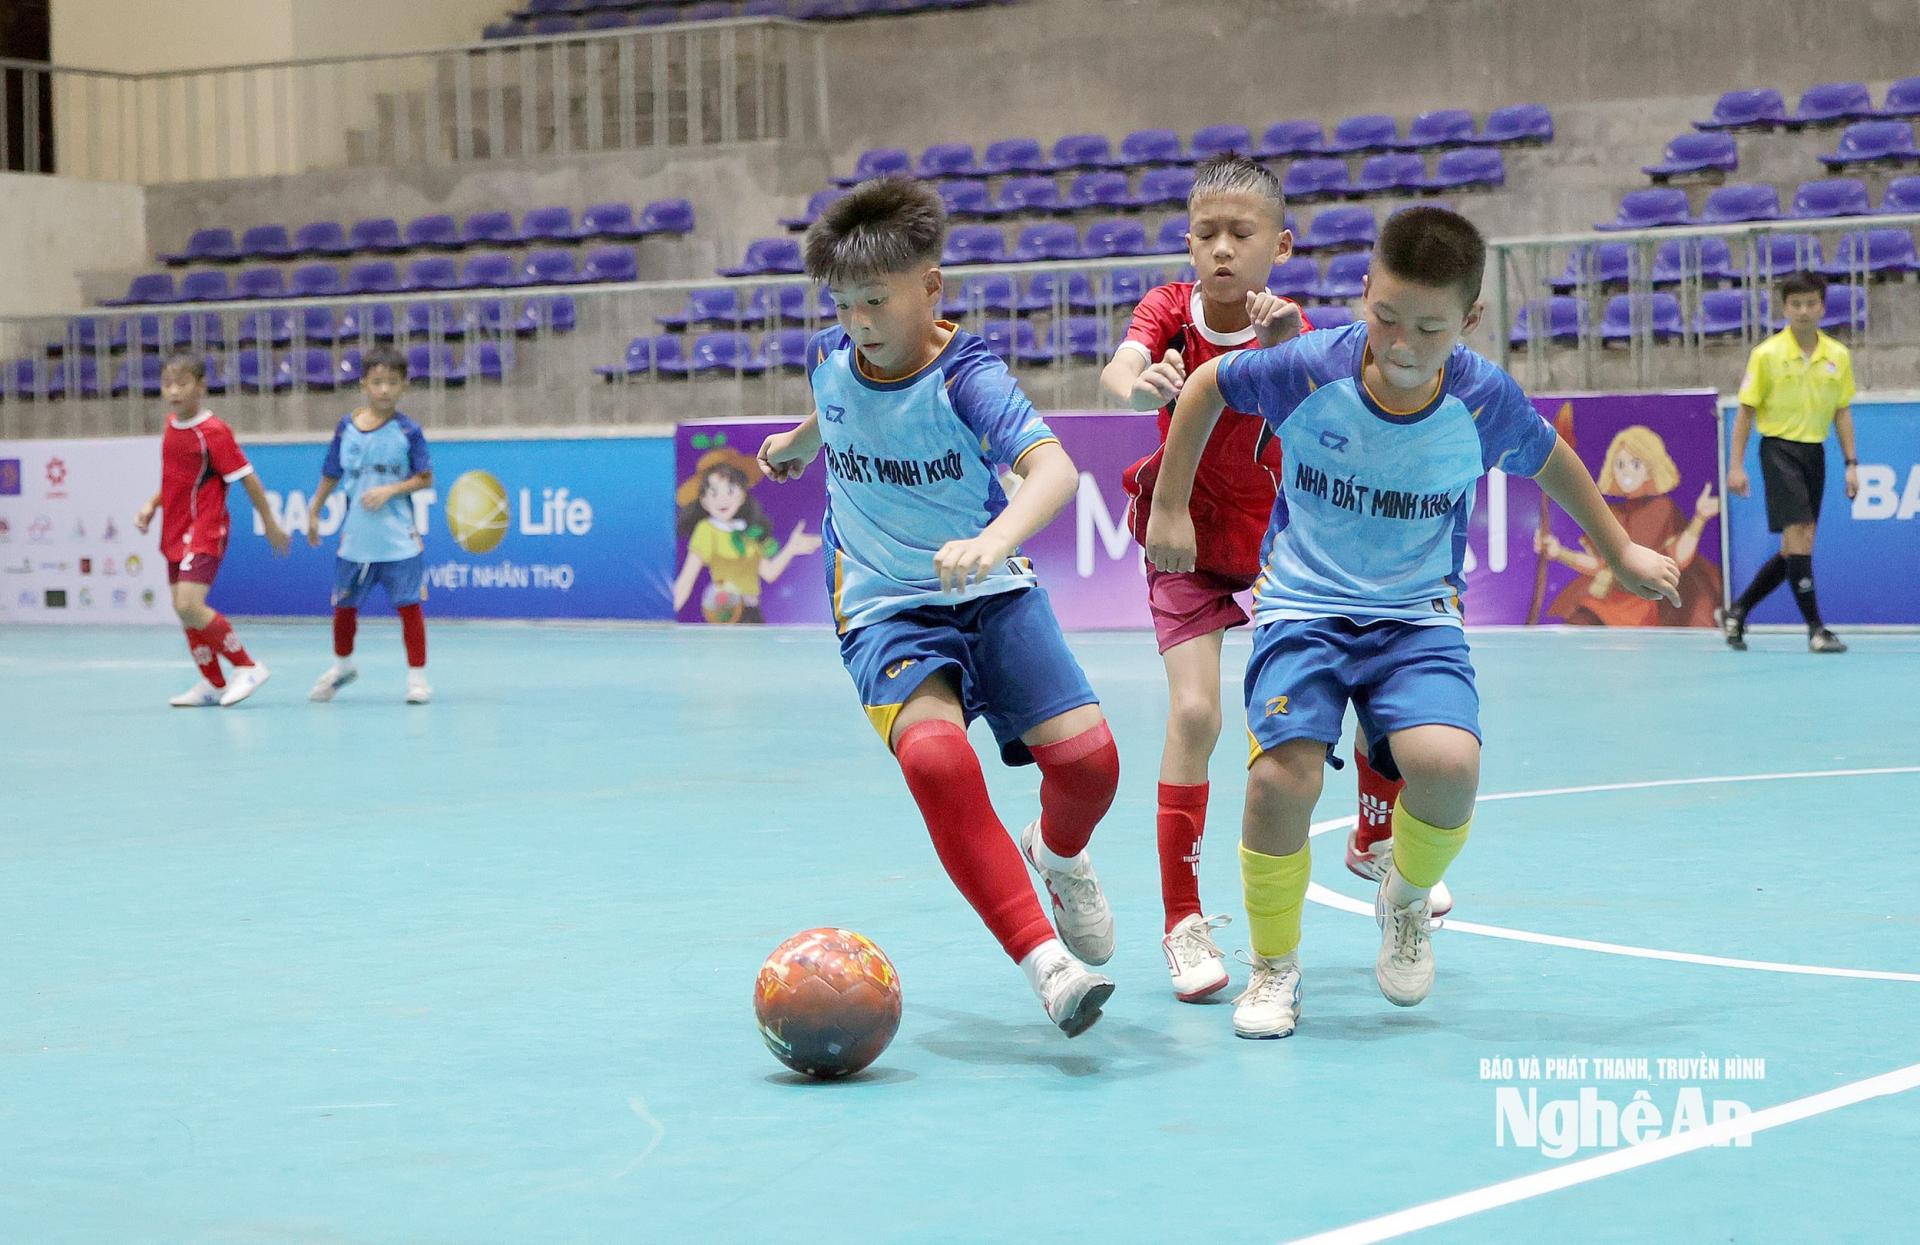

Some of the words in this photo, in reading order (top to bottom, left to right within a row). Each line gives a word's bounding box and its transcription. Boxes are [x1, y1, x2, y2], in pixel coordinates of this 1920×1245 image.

[874, 457, 922, 486] MINH
[924, 449, 964, 484] KHÔI
[519, 487, 593, 536] Life
[1371, 489, 1419, 520] MINH
[472, 560, 529, 588] NHÂN
